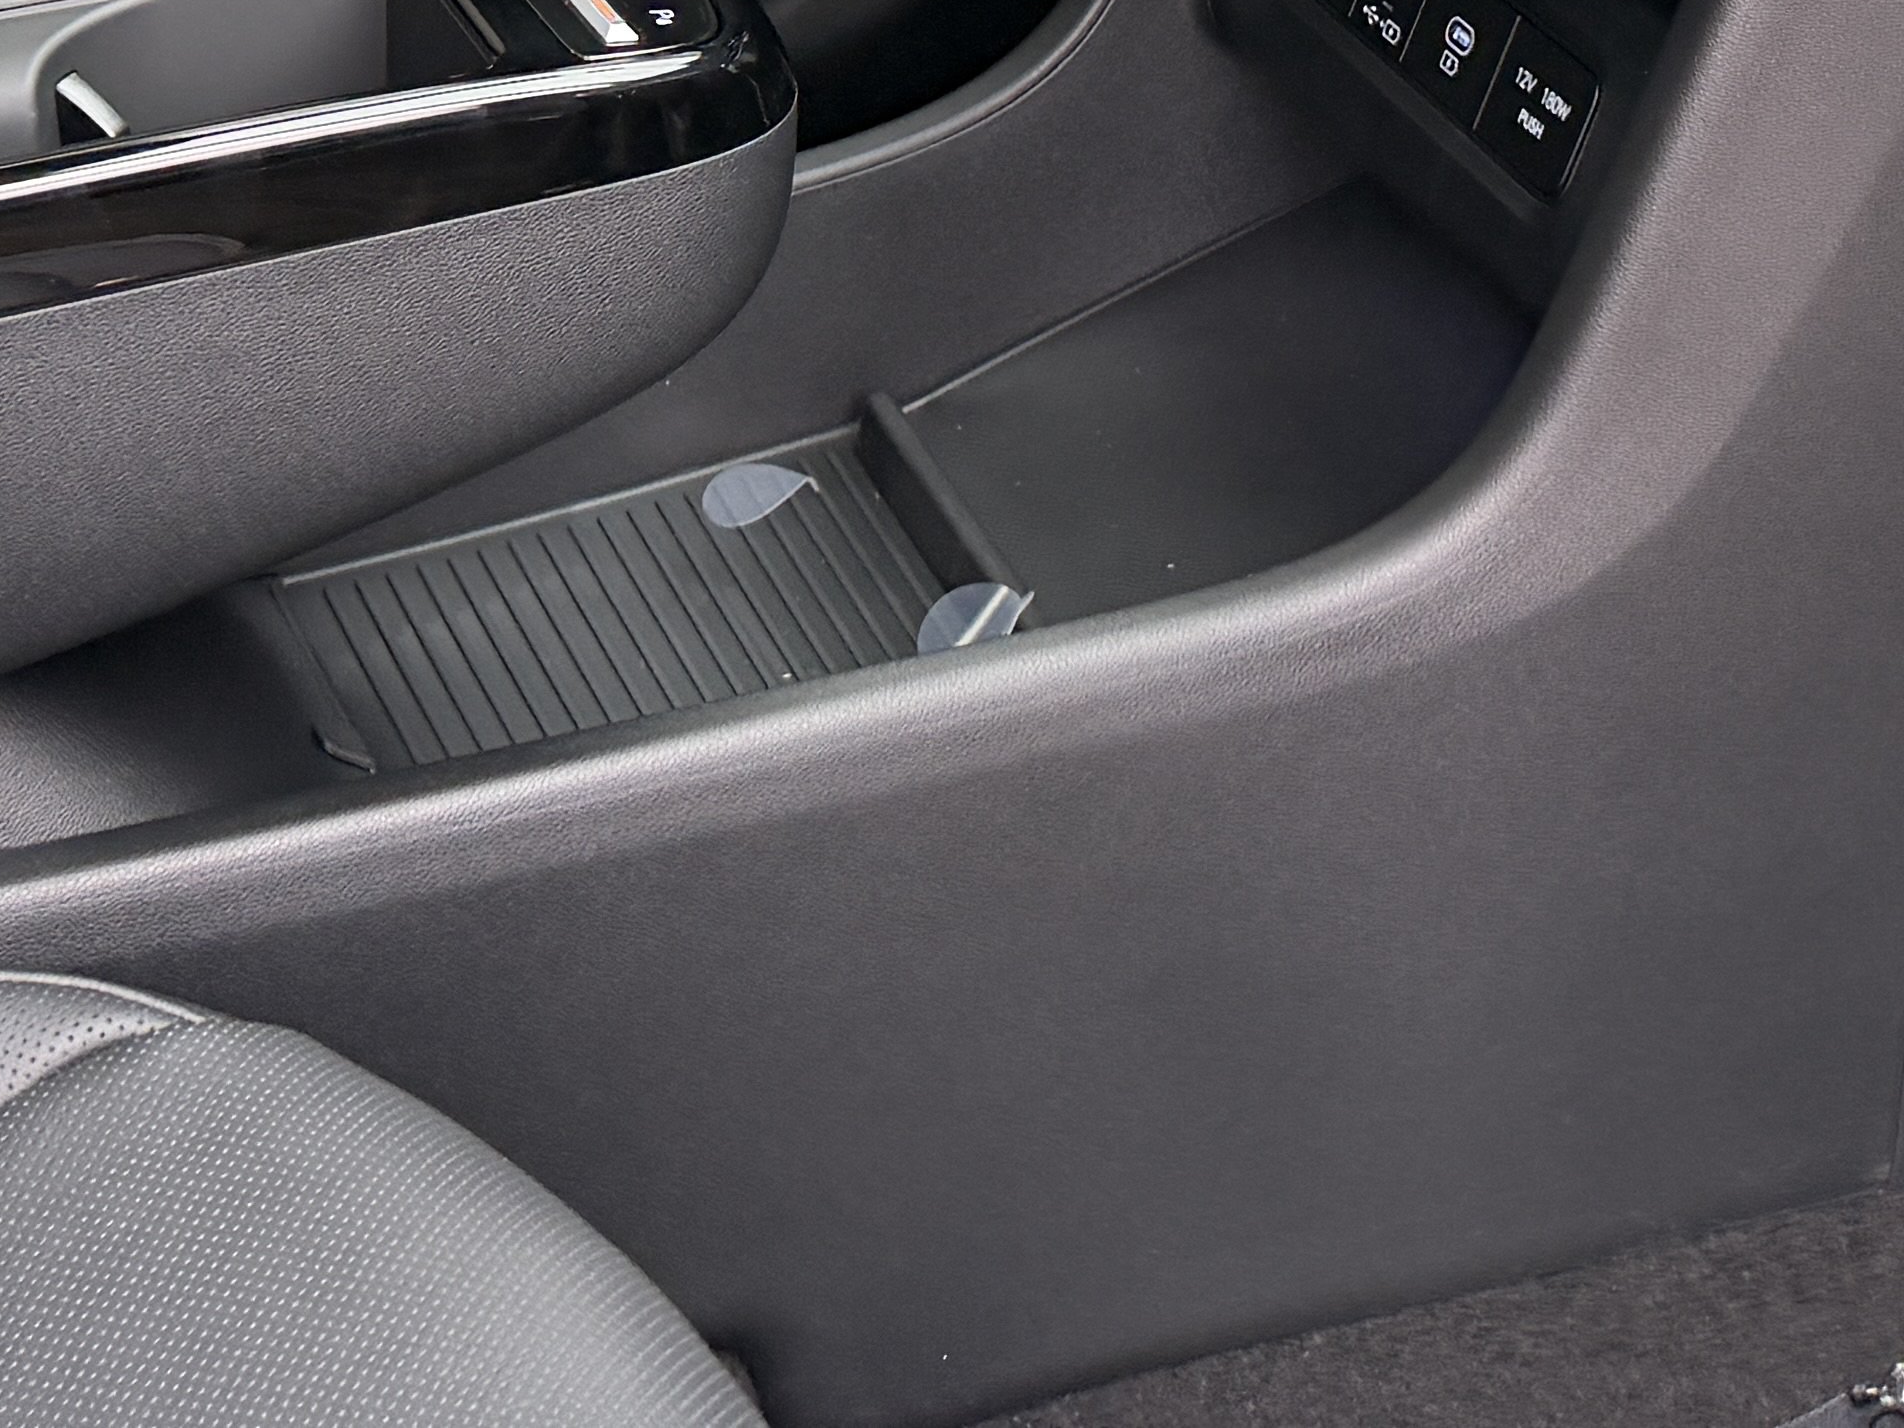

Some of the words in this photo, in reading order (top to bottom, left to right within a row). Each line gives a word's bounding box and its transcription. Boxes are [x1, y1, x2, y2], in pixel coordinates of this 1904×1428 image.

[1515, 66, 1539, 94] 12V
[1540, 86, 1573, 122] 180W
[1516, 107, 1545, 141] PUSH
